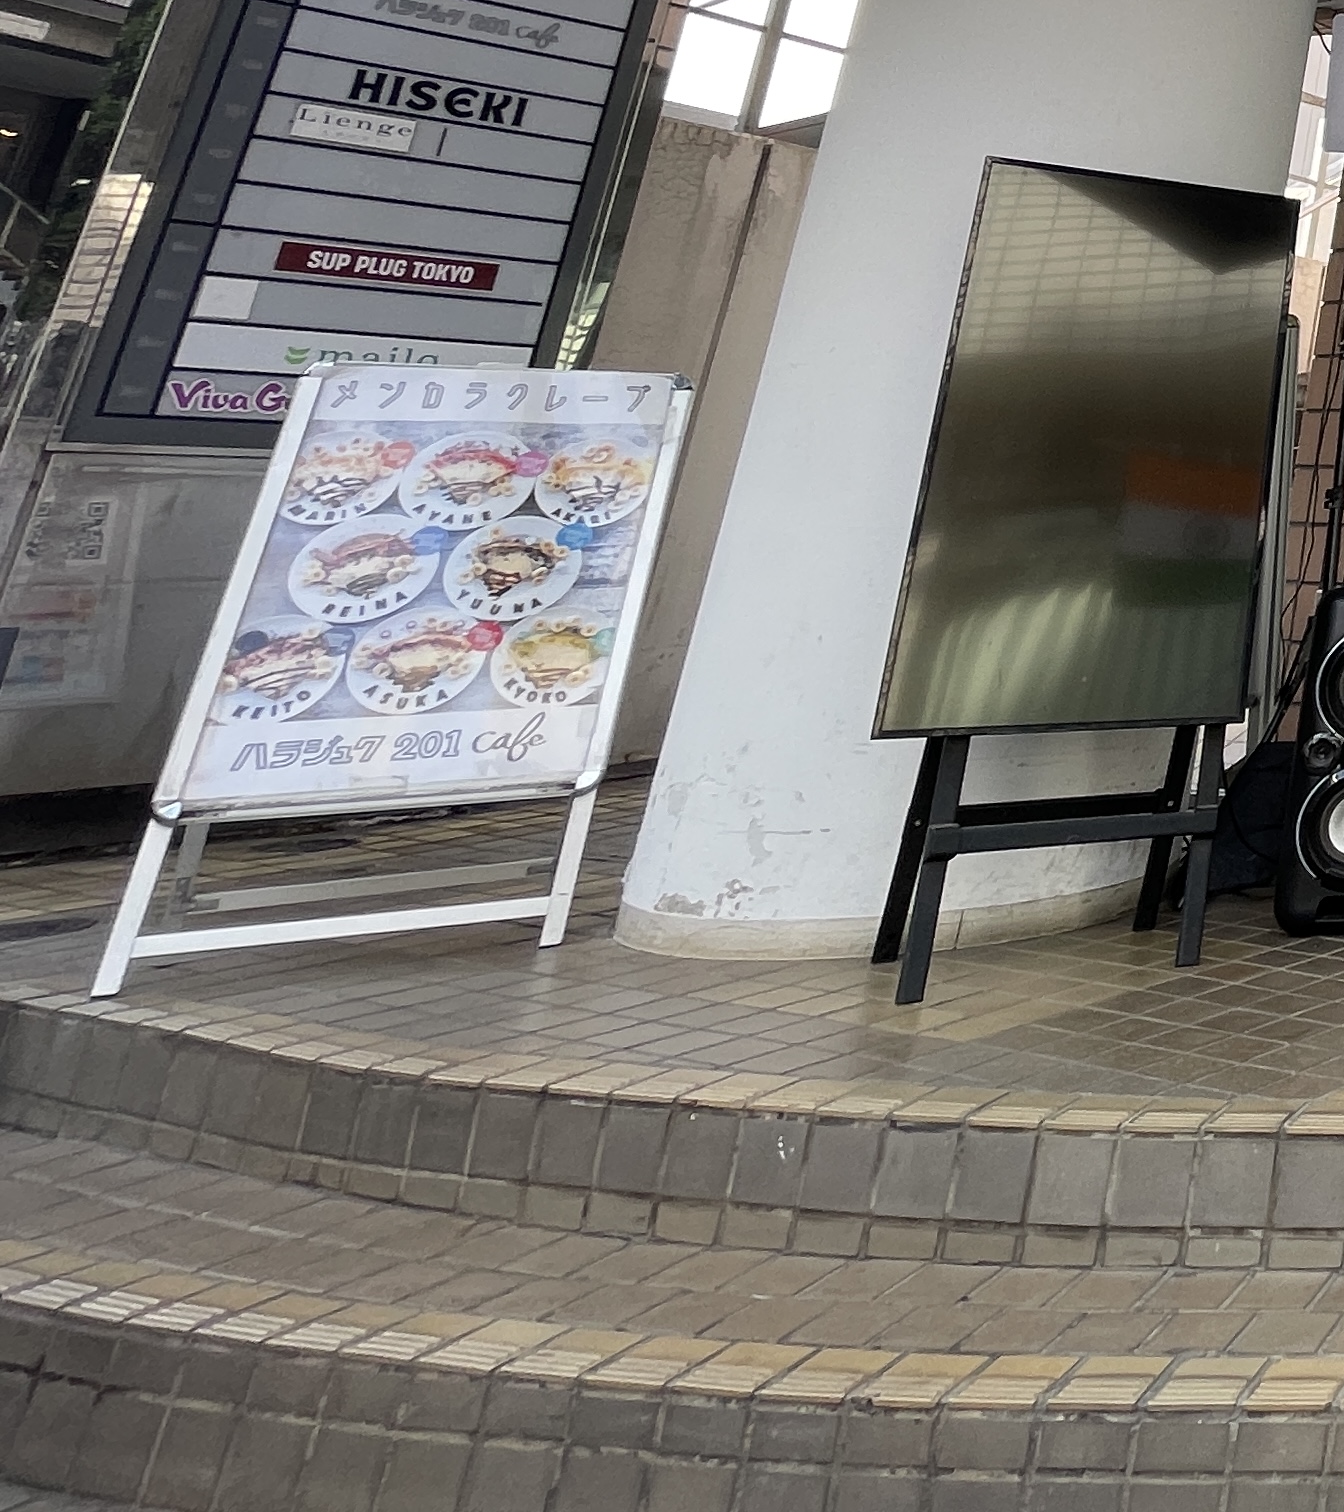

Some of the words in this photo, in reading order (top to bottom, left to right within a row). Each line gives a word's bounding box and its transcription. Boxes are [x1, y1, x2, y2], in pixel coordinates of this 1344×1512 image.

[348, 69, 529, 126] HISEKI
[299, 108, 413, 137] Lienge
[307, 250, 351, 270] SUP
[354, 256, 407, 276] PLUG
[412, 261, 475, 284] TOKYO
[171, 381, 248, 412] Viva
[330, 380, 652, 413] メンカラクレープ
[362, 685, 449, 710] ASUKA
[503, 678, 567, 704] KYOKO
[230, 735, 386, 772] ハラジュク
[390, 729, 463, 761] 201
